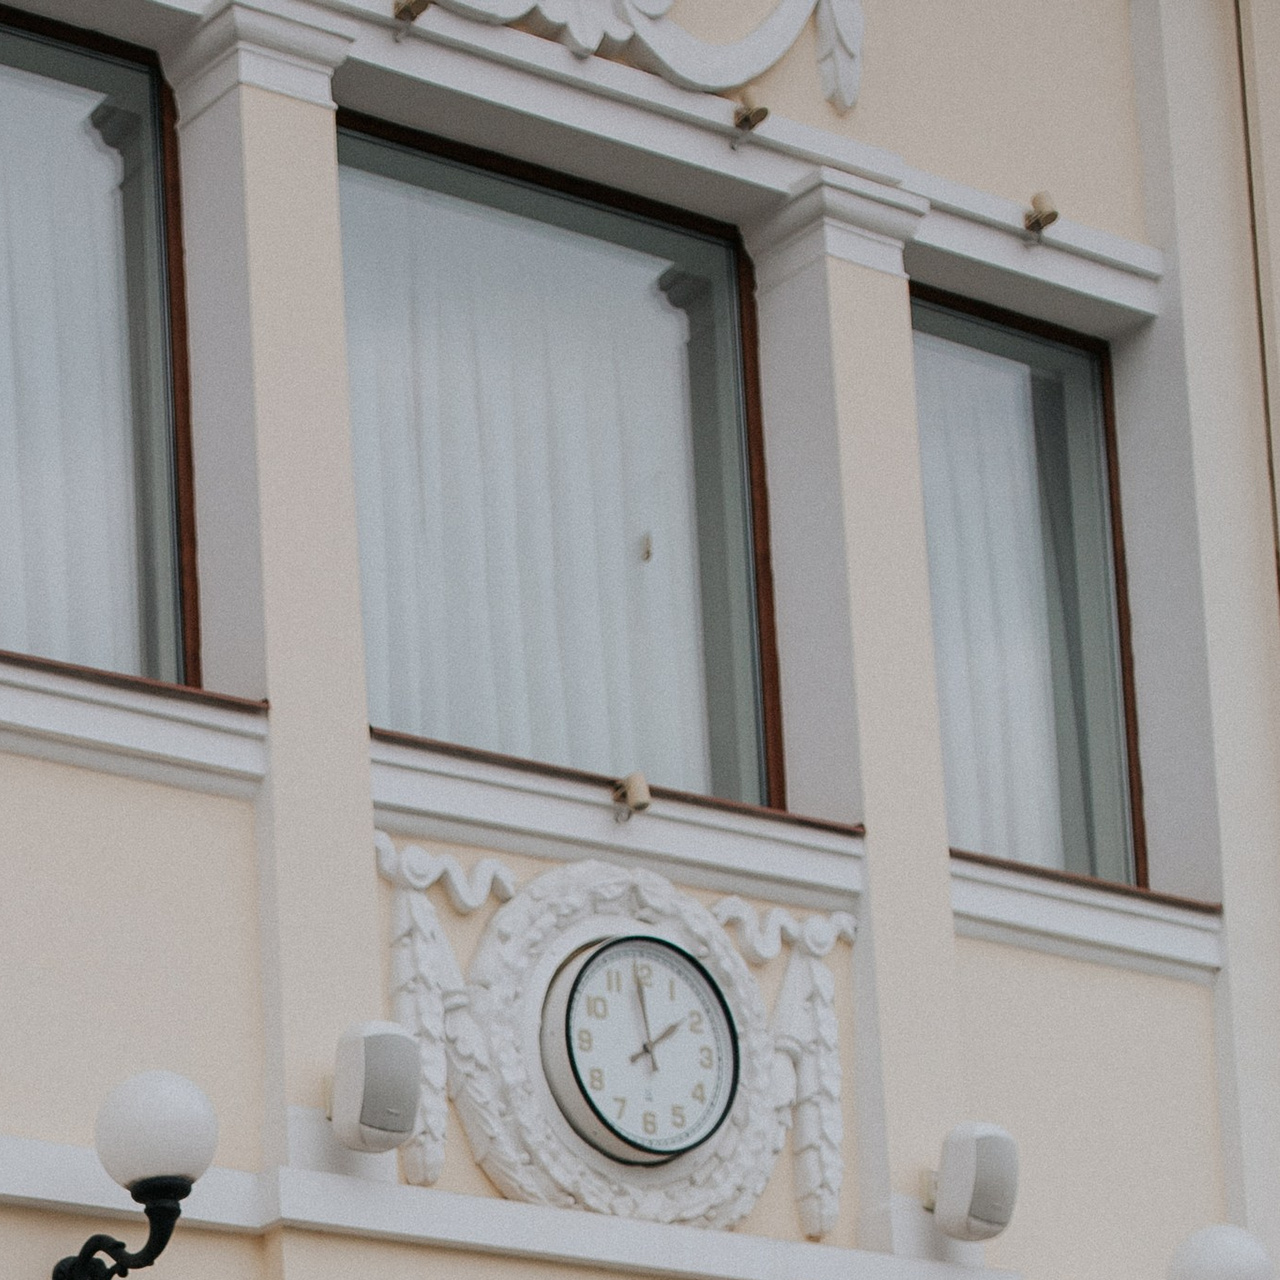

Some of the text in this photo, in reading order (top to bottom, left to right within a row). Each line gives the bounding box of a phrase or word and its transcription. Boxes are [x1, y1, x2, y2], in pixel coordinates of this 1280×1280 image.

[607, 969, 620, 993] 11
[587, 996, 607, 1019] 10
[689, 1010, 703, 1034] 2
[578, 1029, 592, 1052] 9
[699, 1046, 713, 1069] 3
[589, 1068, 604, 1091] 8
[692, 1084, 706, 1105] 4
[613, 1098, 626, 1120] 7
[672, 1106, 685, 1128] 5
[643, 1112, 657, 1134] 6
